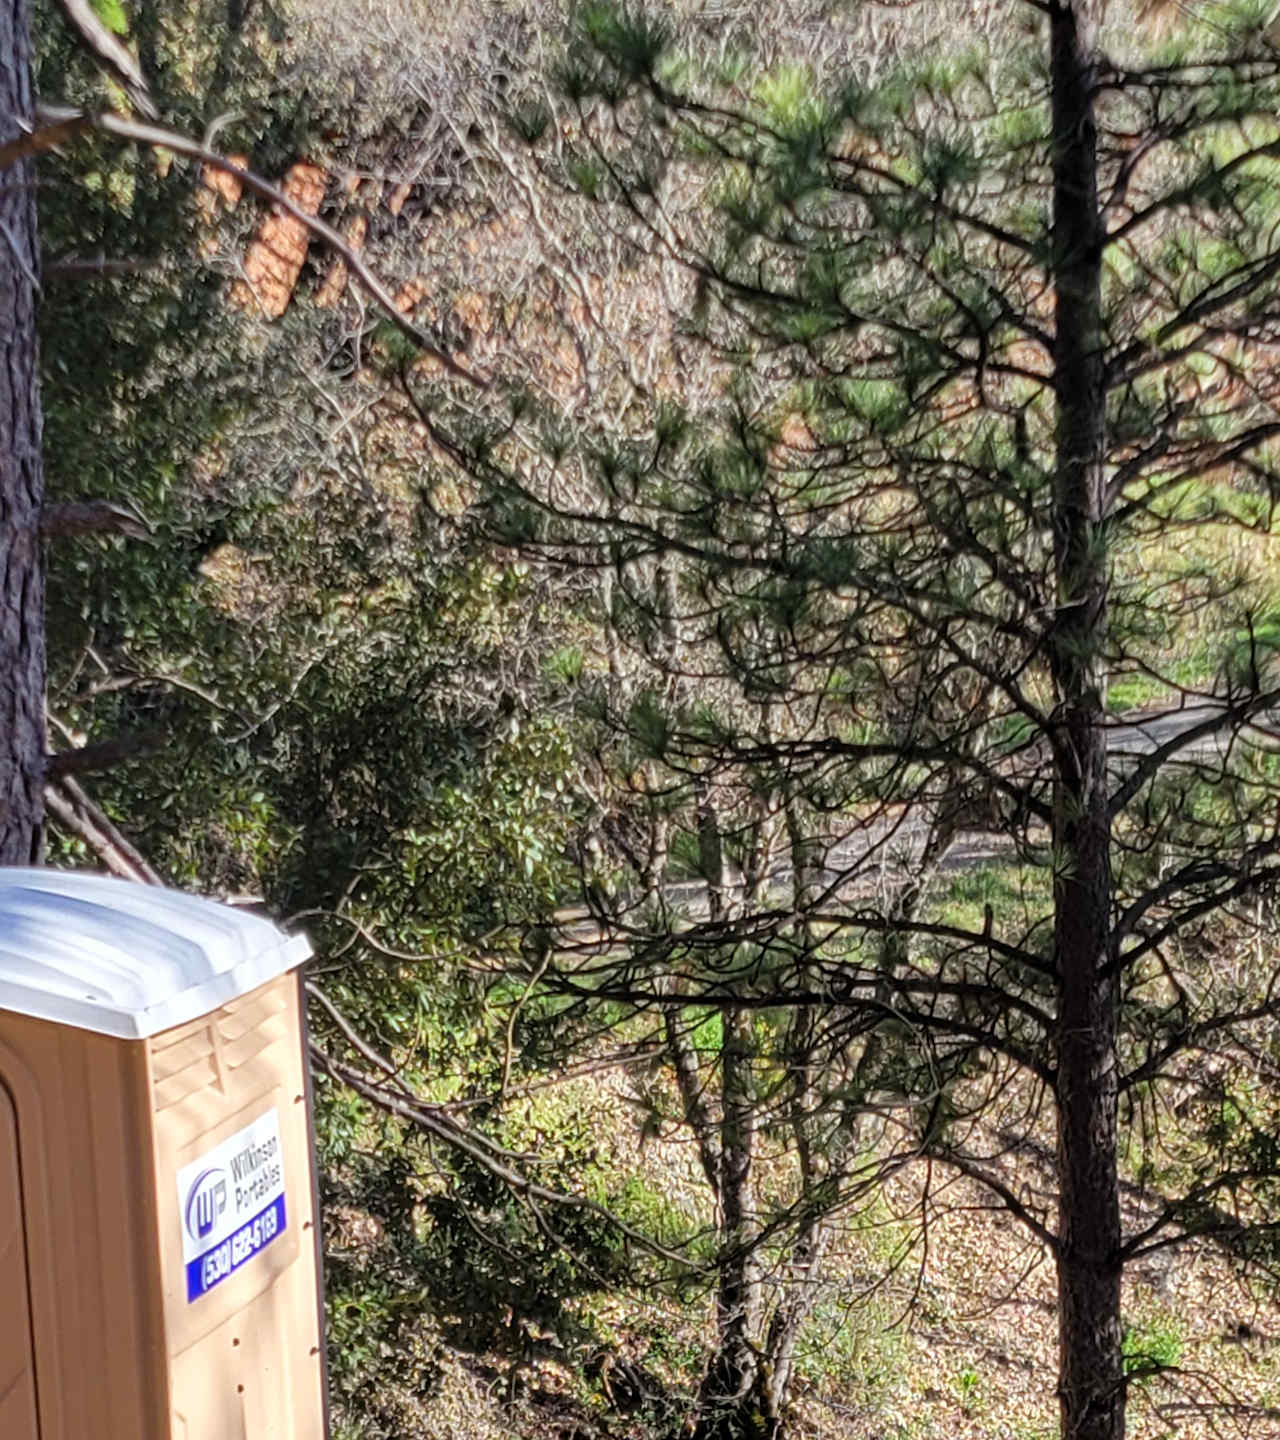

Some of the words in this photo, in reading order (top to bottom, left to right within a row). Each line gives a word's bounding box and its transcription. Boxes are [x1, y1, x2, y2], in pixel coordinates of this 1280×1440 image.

[230, 1136, 278, 1184] Wilkinson
[196, 1179, 227, 1240] WP
[235, 1164, 281, 1212] Portables
